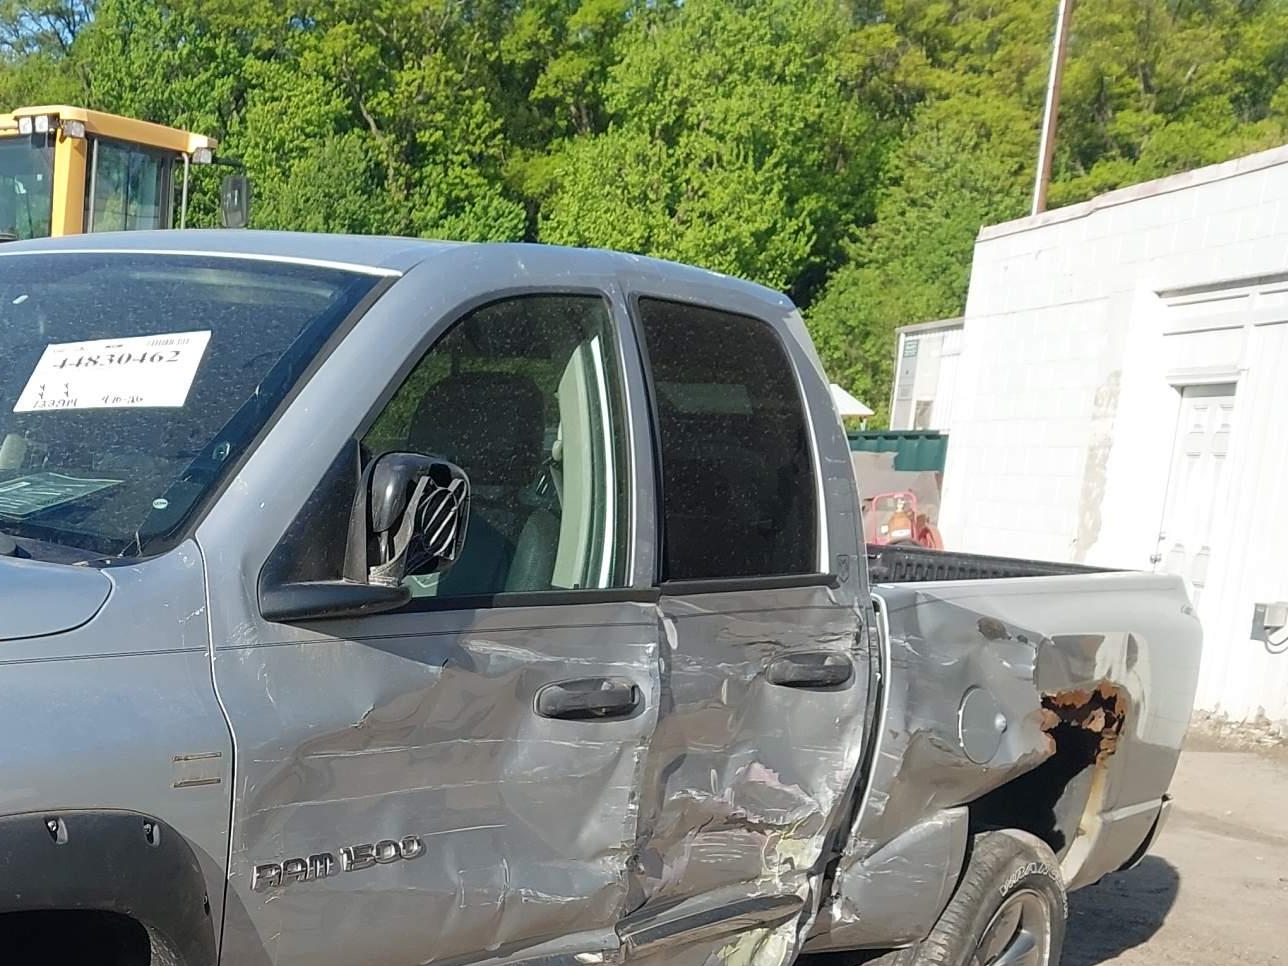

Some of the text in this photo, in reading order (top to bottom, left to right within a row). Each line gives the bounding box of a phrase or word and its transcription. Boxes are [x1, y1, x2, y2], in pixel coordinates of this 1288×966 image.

[52, 350, 182, 369] 44830462
[250, 833, 426, 892] RAM 1500
